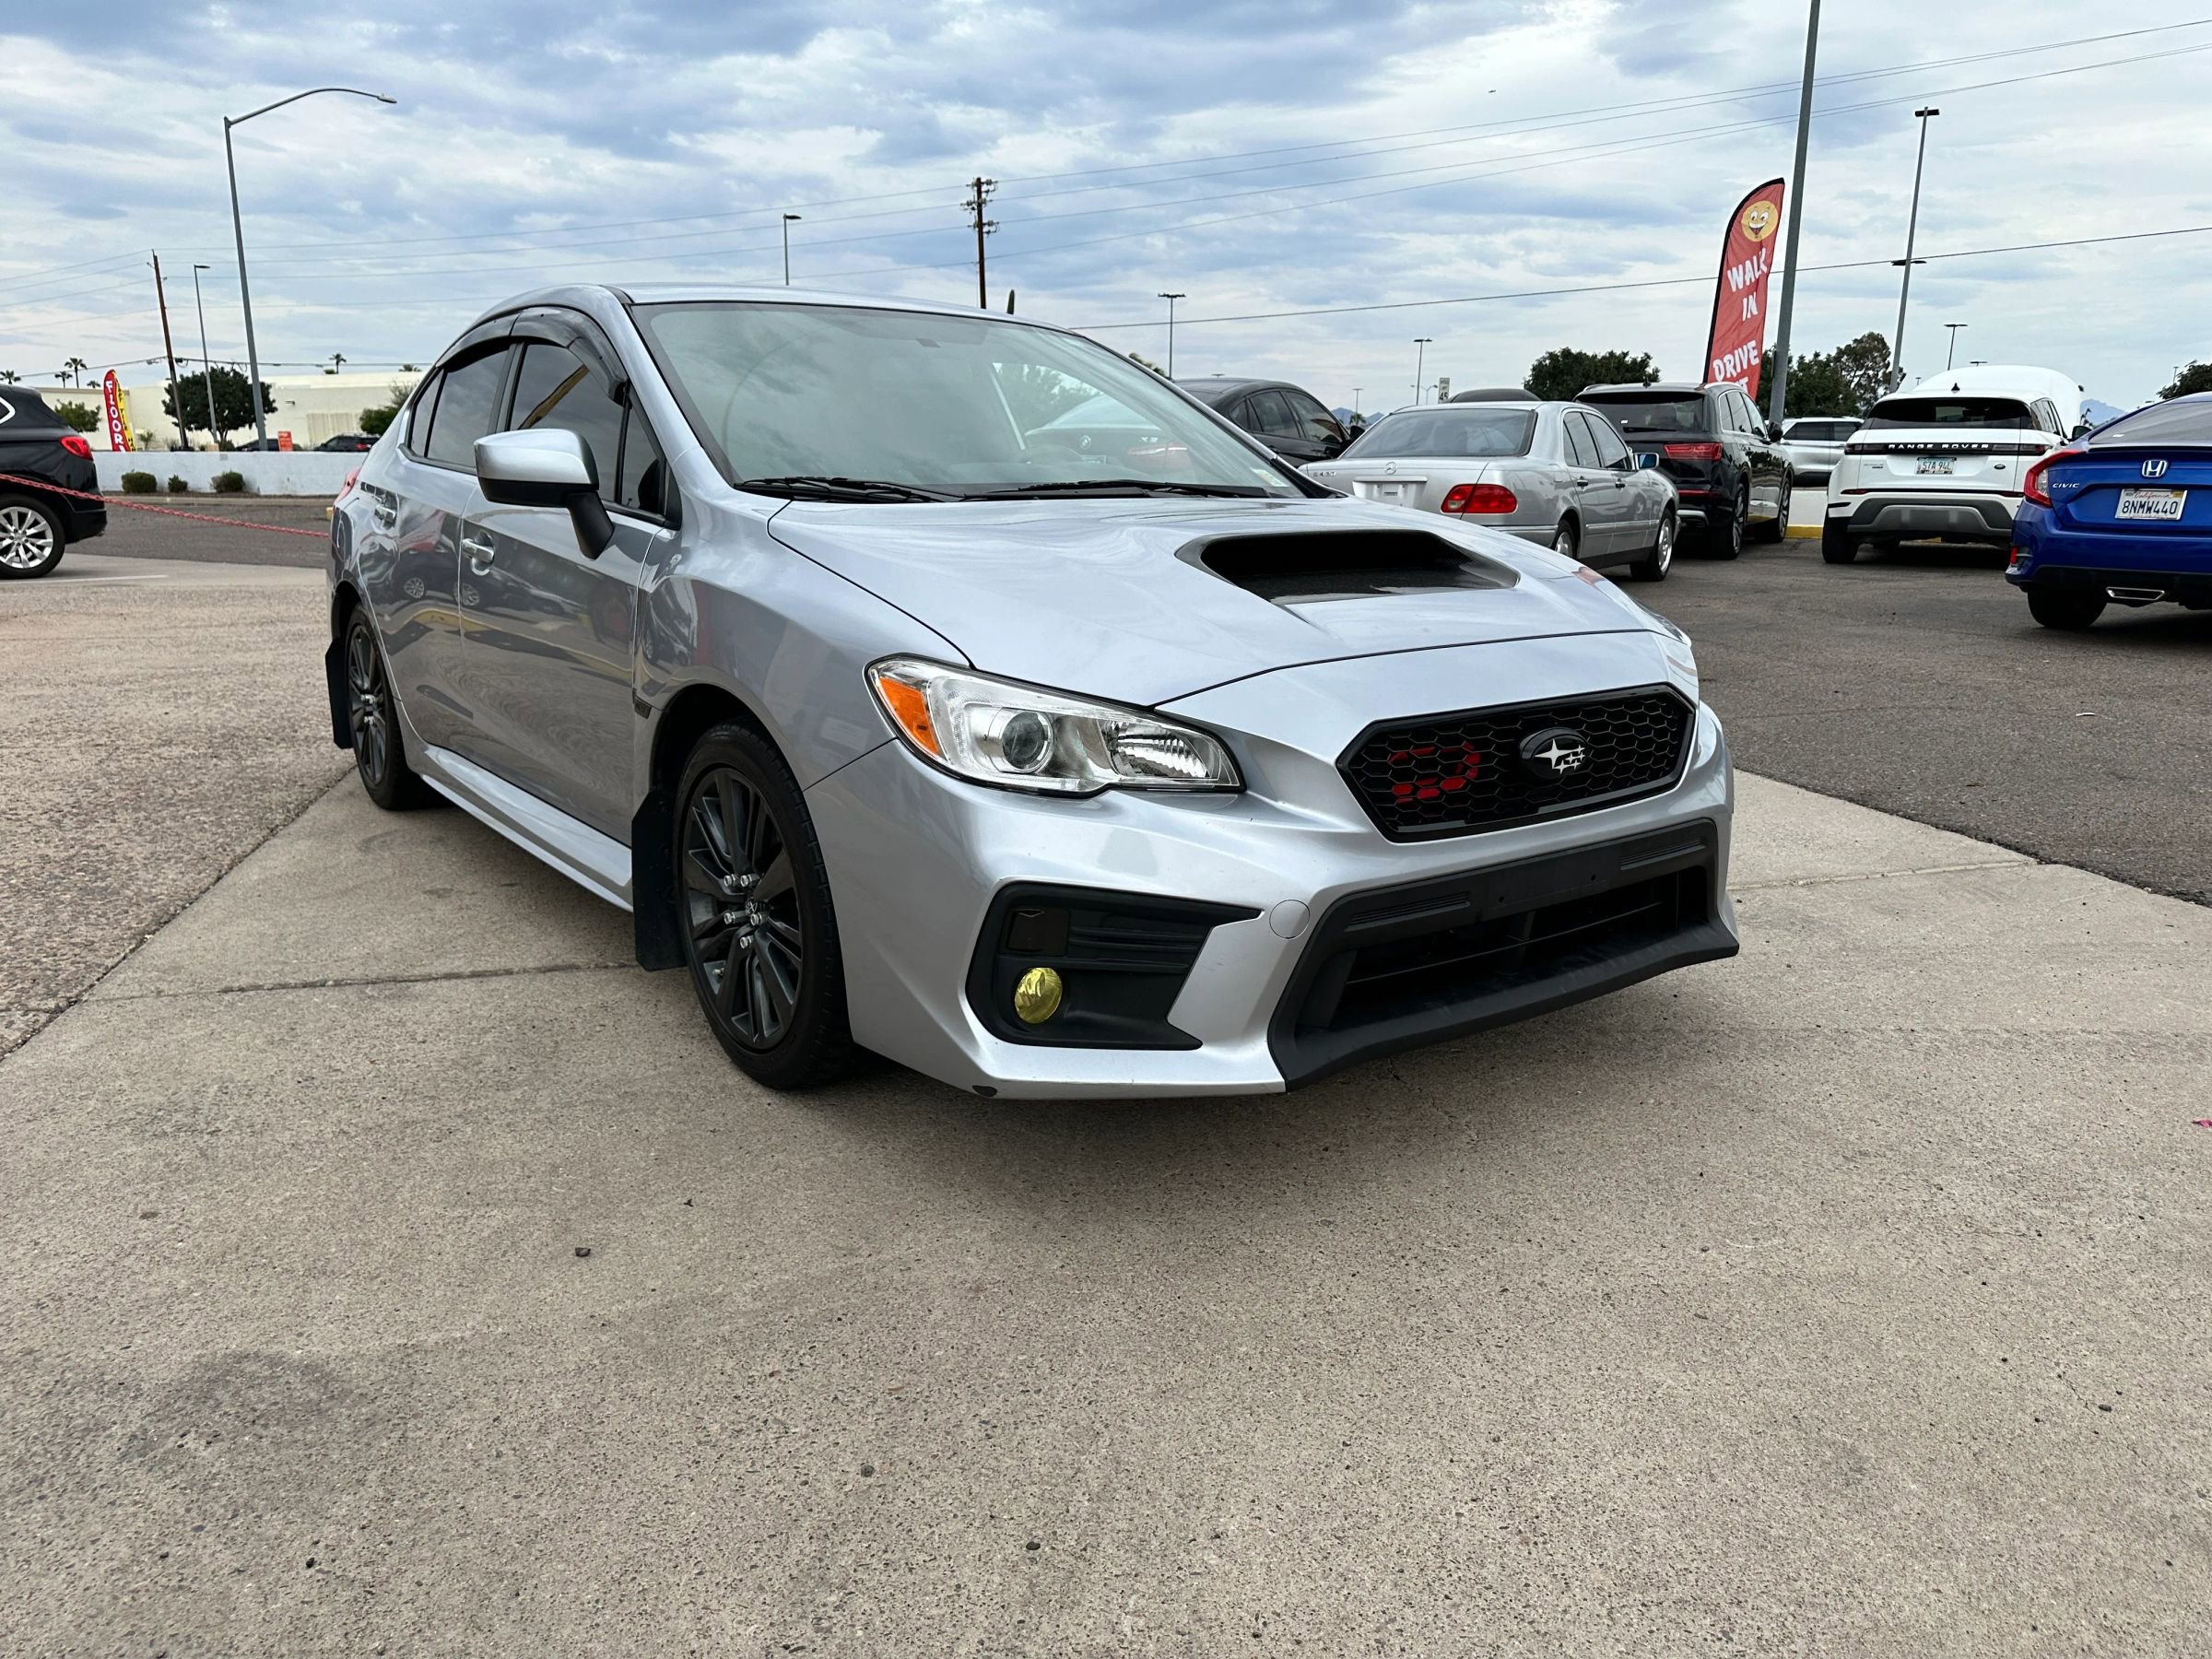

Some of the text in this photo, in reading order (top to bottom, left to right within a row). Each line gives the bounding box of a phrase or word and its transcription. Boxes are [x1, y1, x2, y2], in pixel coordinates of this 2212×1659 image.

[1727, 247, 1768, 292] WALK
[1742, 291, 1759, 322] IN
[1712, 340, 1759, 382] DRIVE
[1439, 392, 1448, 400] 45
[2122, 500, 2179, 514] 8NMW440
